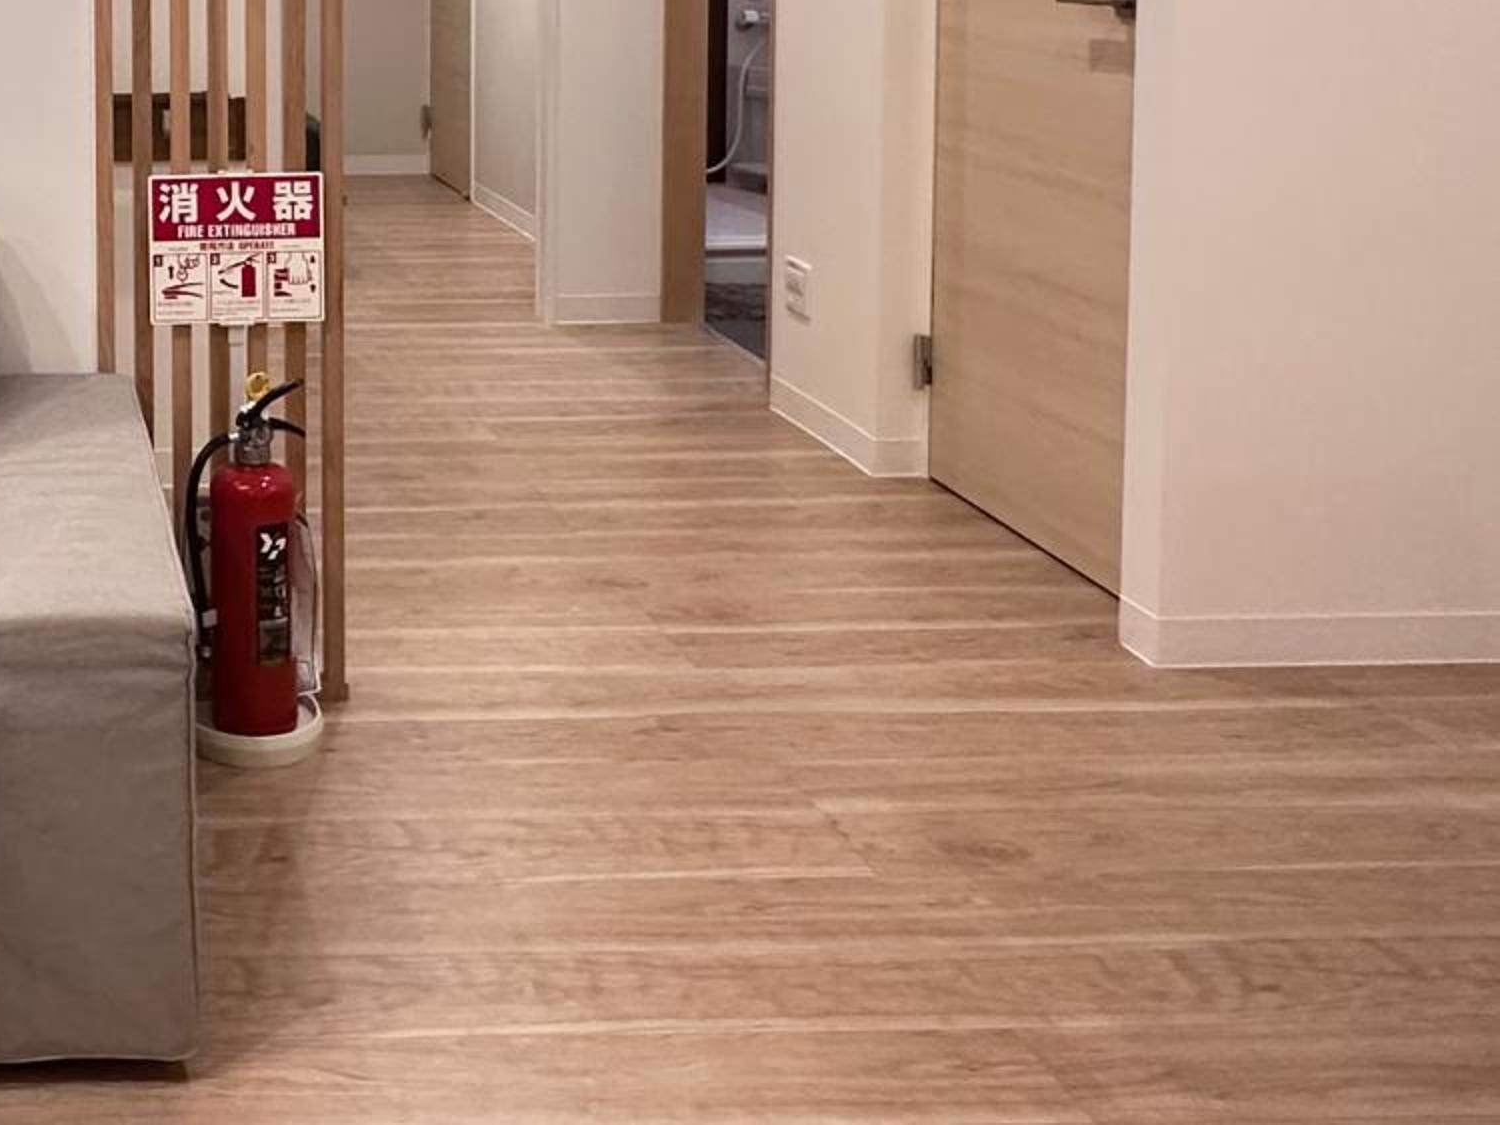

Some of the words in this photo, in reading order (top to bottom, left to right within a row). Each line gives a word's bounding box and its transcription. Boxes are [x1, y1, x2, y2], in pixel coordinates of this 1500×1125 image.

[158, 180, 313, 223] 消火器
[177, 224, 204, 239] FIRE
[208, 222, 297, 238] EXTINGUISHER
